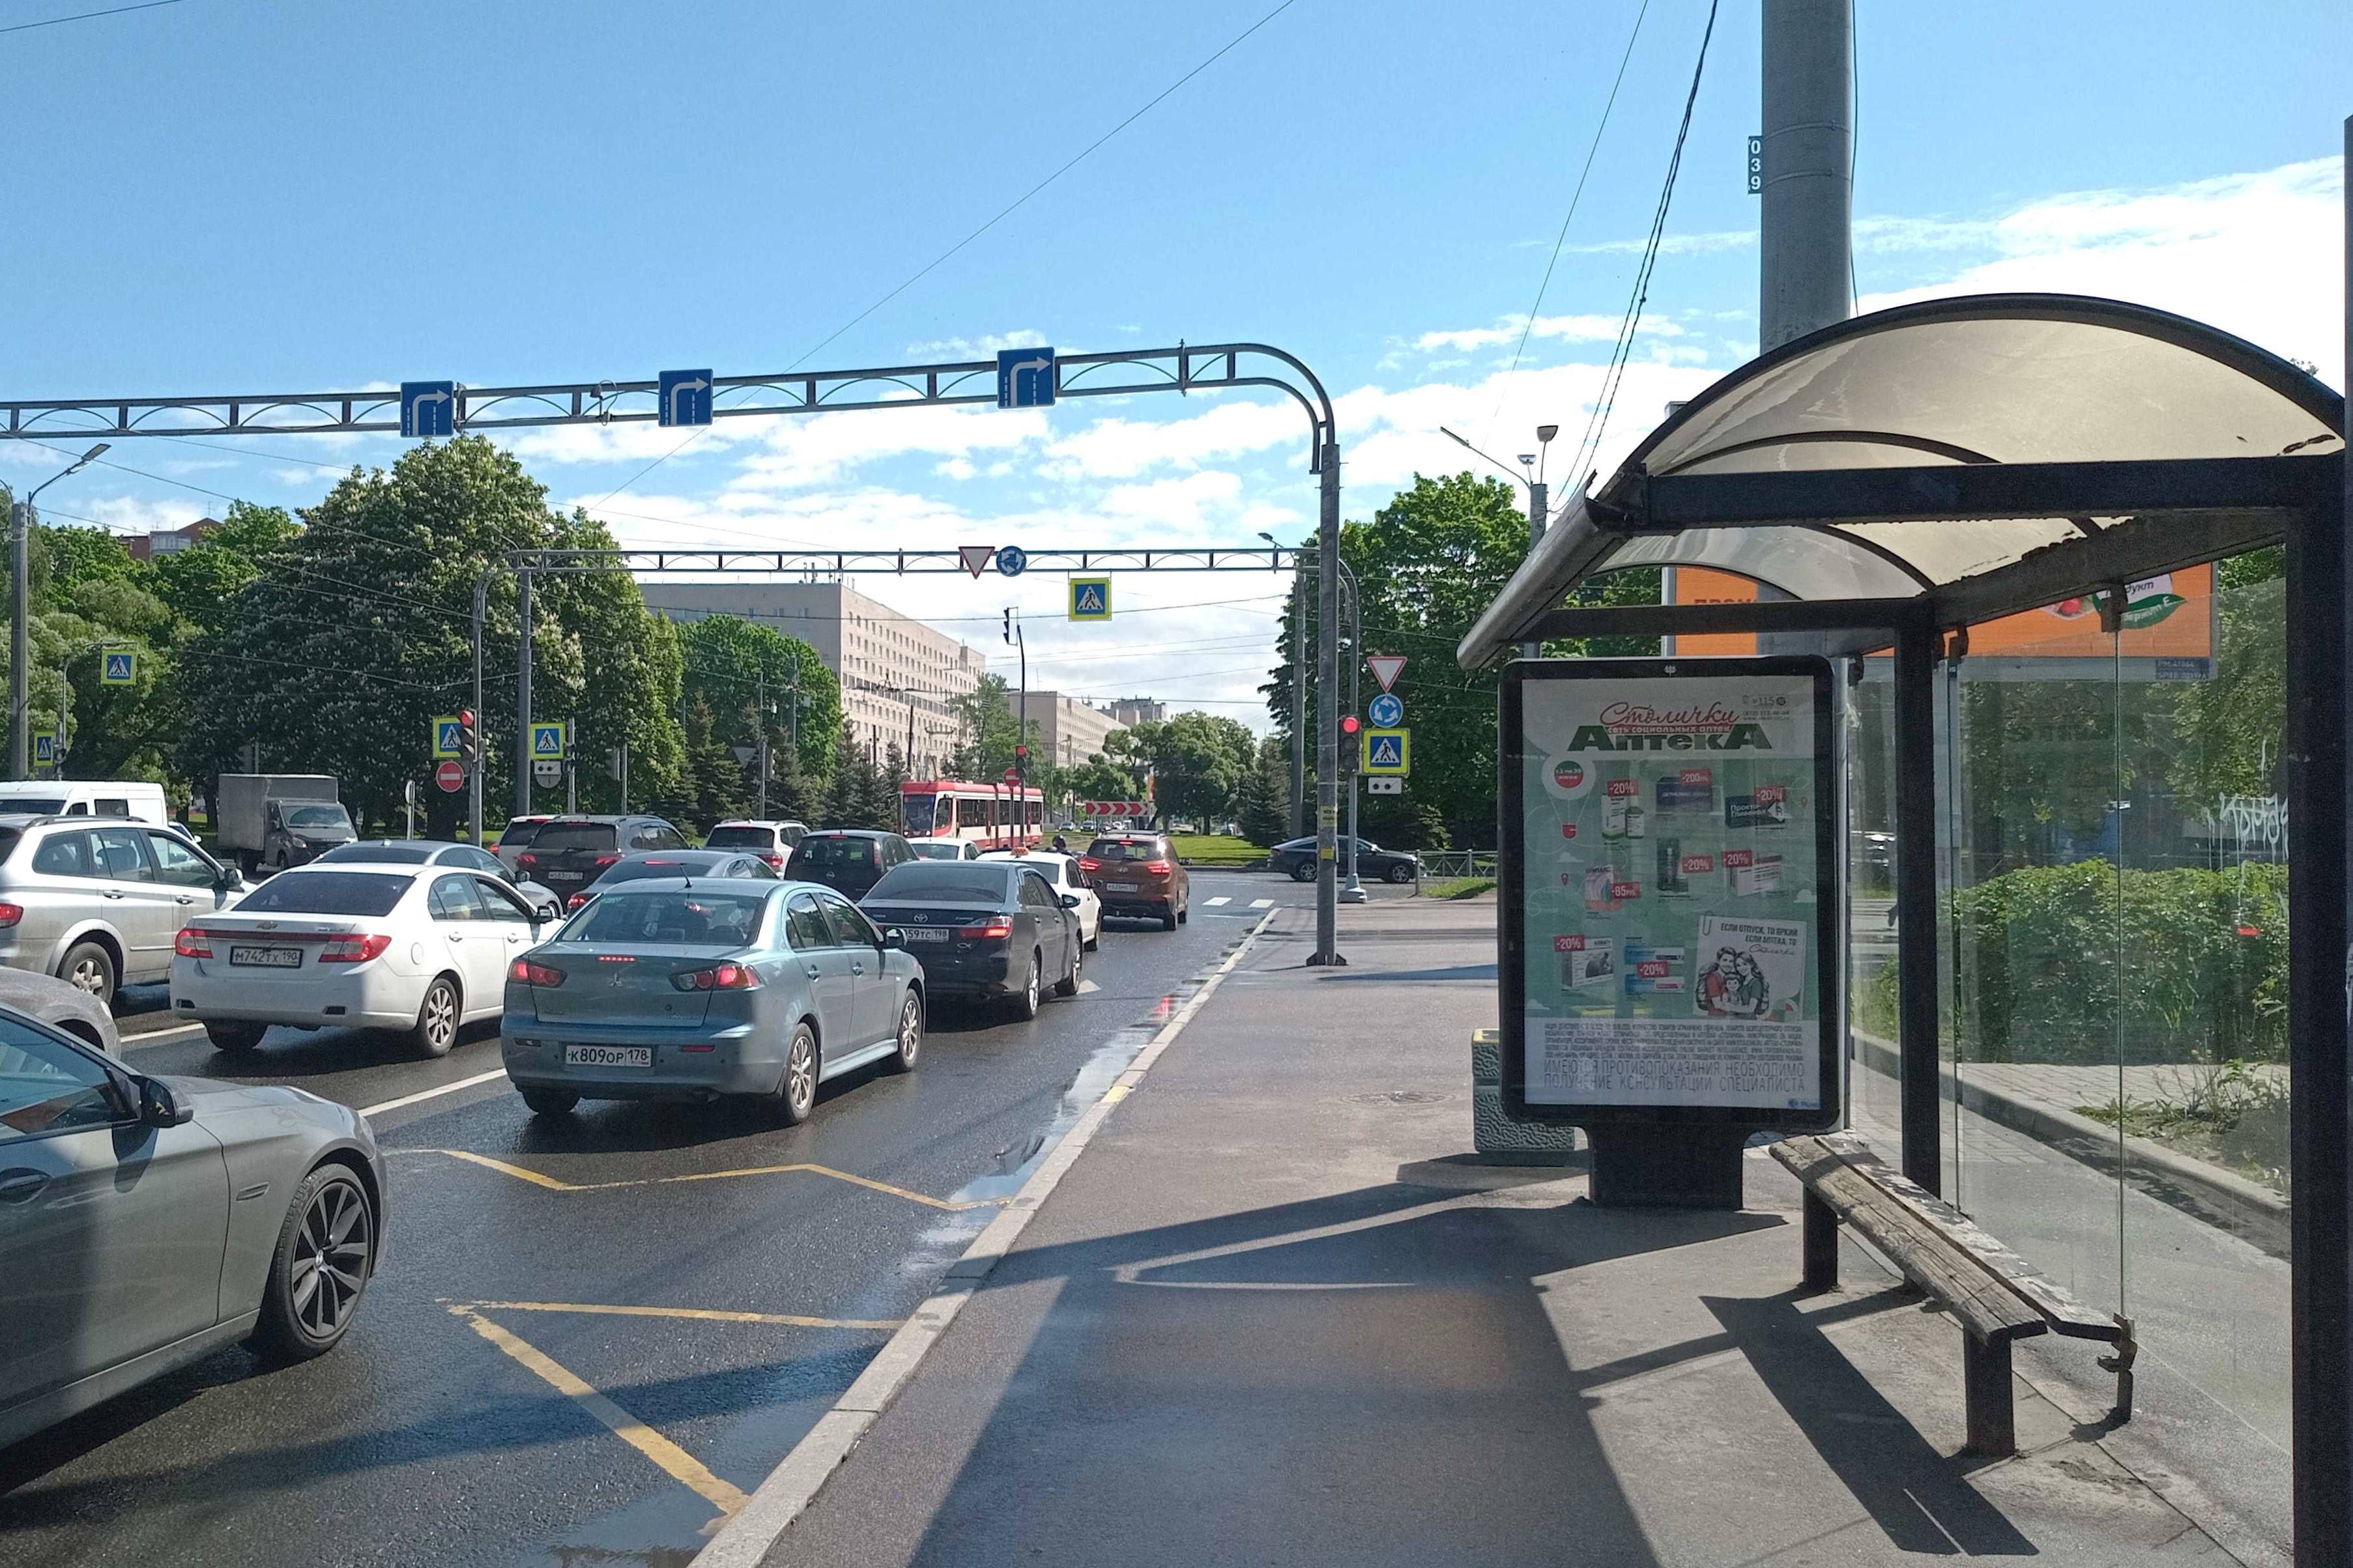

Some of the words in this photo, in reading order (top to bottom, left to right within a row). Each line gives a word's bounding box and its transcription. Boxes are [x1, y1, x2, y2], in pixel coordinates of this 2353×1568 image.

[1750, 139, 1761, 190] 039
[1600, 701, 1740, 725] Столички
[1632, 726, 1697, 734] социальных
[1699, 725, 1730, 734] аптек
[1609, 782, 1635, 794] -20%
[1684, 859, 1709, 870] -20%
[1724, 853, 1749, 865] -20%
[906, 929, 931, 939] 59ТС
[1721, 923, 1738, 932] ЕСЛИ
[1767, 926, 1775, 935] ТО
[1556, 937, 1581, 949] -20%
[282, 951, 297, 960] 190
[1639, 963, 1664, 976] -20%
[571, 1048, 624, 1063] К809ОР
[628, 1049, 648, 1061] 178
[1725, 1061, 1804, 1077] НЕОБХОДИМО
[1620, 1075, 1712, 1092] КОНСУЛЬТАЦИИ
[1719, 1077, 1804, 1092] СПЕЦИАЛИСТА
